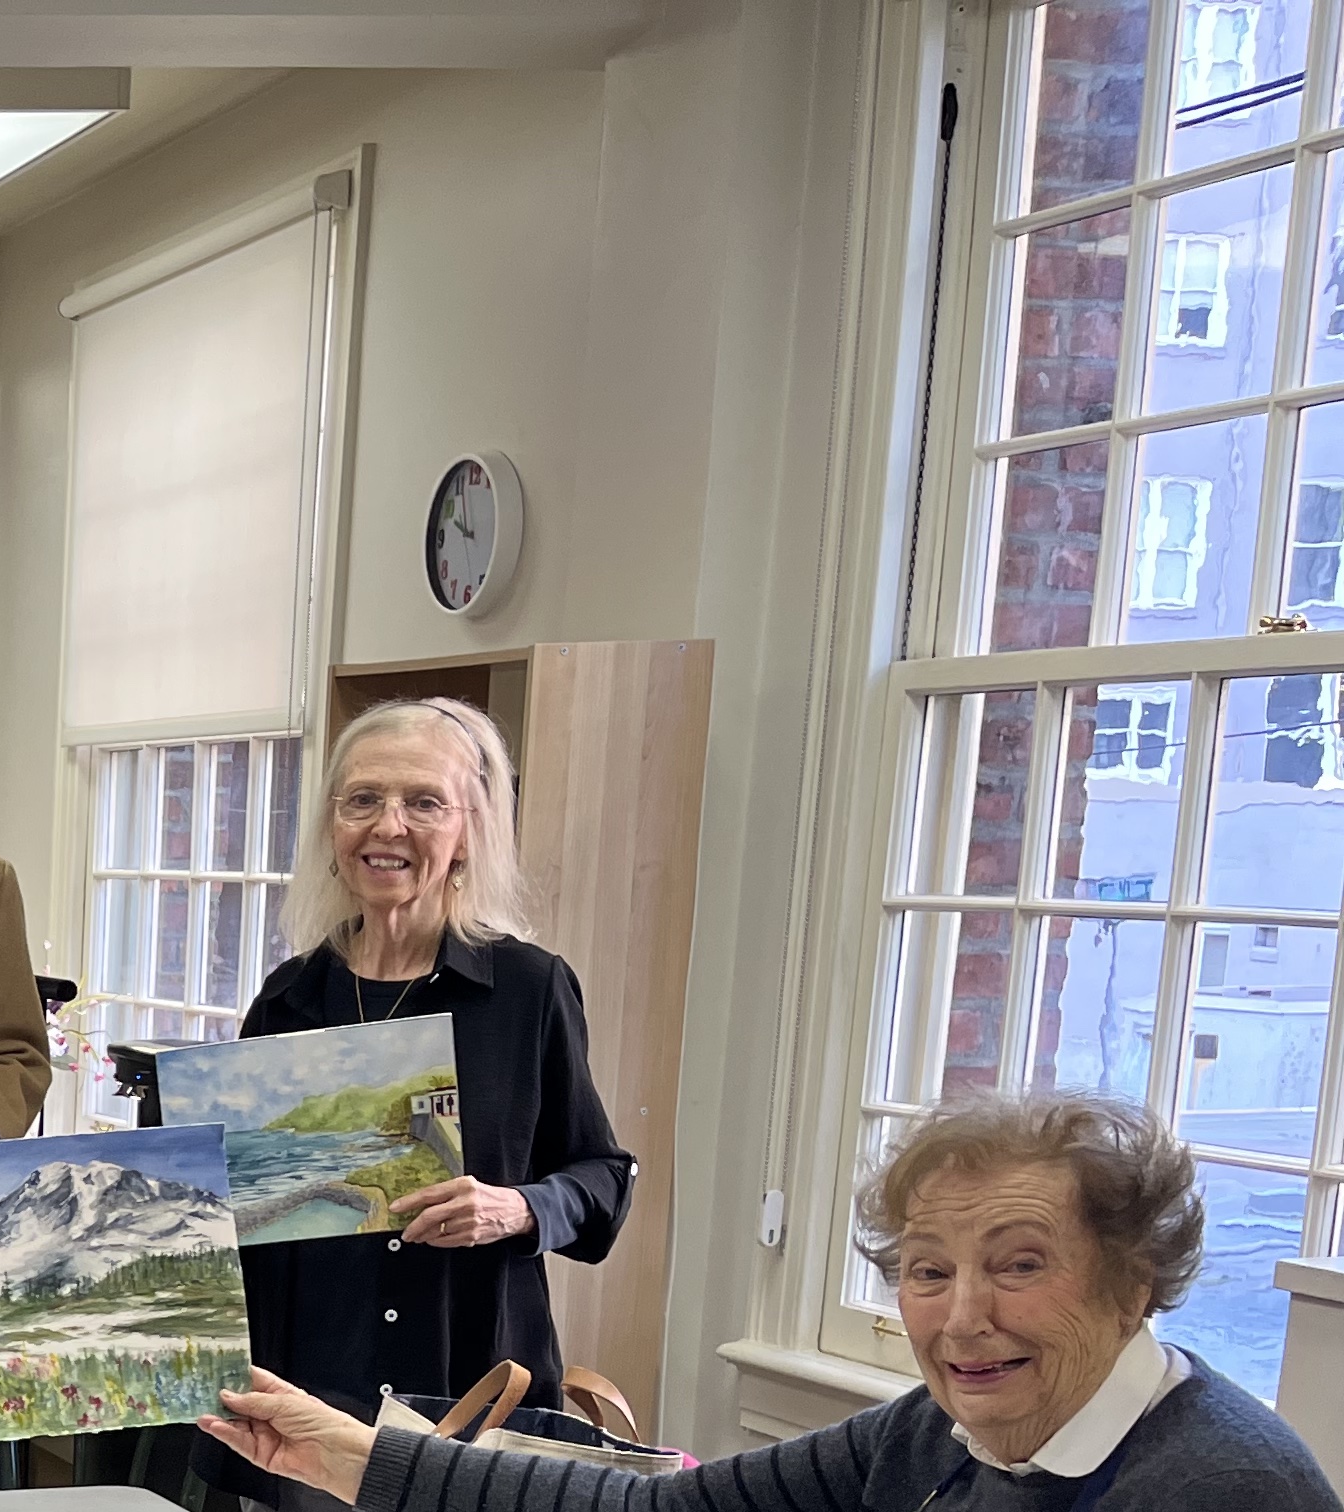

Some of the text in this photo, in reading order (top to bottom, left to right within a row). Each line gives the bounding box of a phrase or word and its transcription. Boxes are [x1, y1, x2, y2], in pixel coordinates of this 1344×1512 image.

[468, 463, 482, 486] 12
[437, 528, 445, 549] 9
[440, 559, 449, 580] 8
[450, 578, 458, 600] 7
[463, 584, 472, 604] 6
